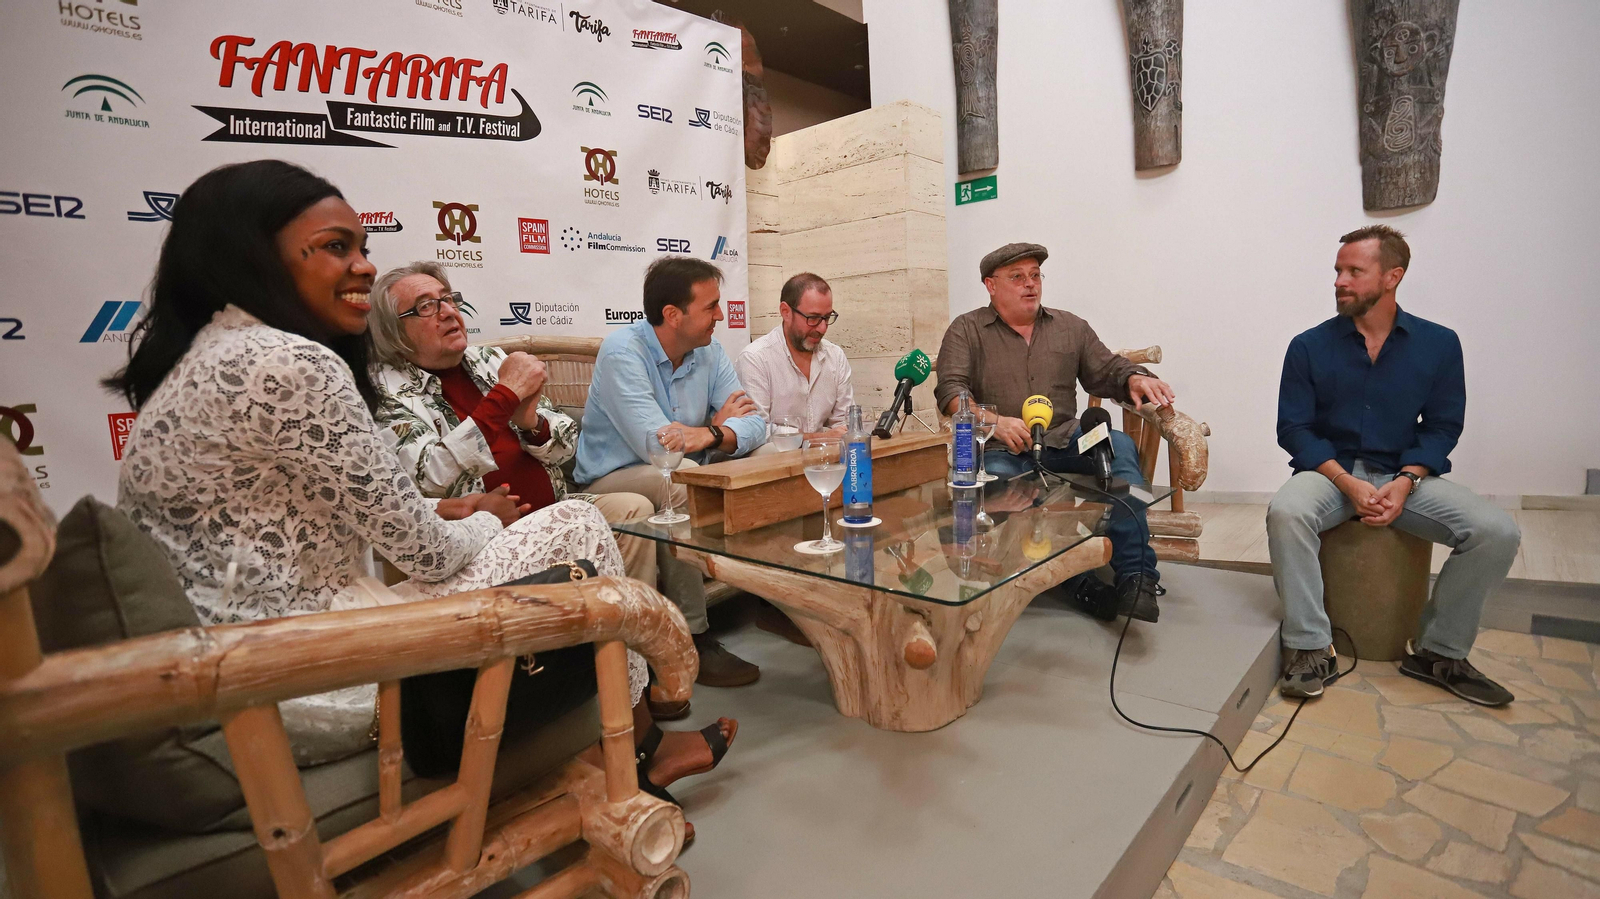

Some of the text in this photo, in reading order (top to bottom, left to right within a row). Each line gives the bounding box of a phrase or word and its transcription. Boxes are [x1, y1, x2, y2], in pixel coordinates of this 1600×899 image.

[58, 0, 141, 30] HOTELS
[510, 0, 557, 24] TARIFA
[569, 10, 611, 43] Tarifa
[209, 35, 508, 109] FANTARIFA
[65, 110, 91, 121] JUNTA
[95, 114, 105, 122] DE
[637, 104, 673, 123] SER
[229, 115, 326, 139] International
[346, 108, 520, 138] Fantastic Film and T.V. Festival
[714, 123, 722, 131] de
[584, 188, 619, 201] HOTELS
[660, 181, 697, 195] TARIFA
[0, 191, 86, 219] SER
[522, 222, 546, 233] SPAIN
[523, 234, 546, 243] FILM
[656, 238, 691, 253] SER
[436, 249, 483, 261] HOTELS
[535, 302, 579, 313] Diputación
[536, 315, 573, 325] de Cádiz
[605, 308, 644, 324] Europa
